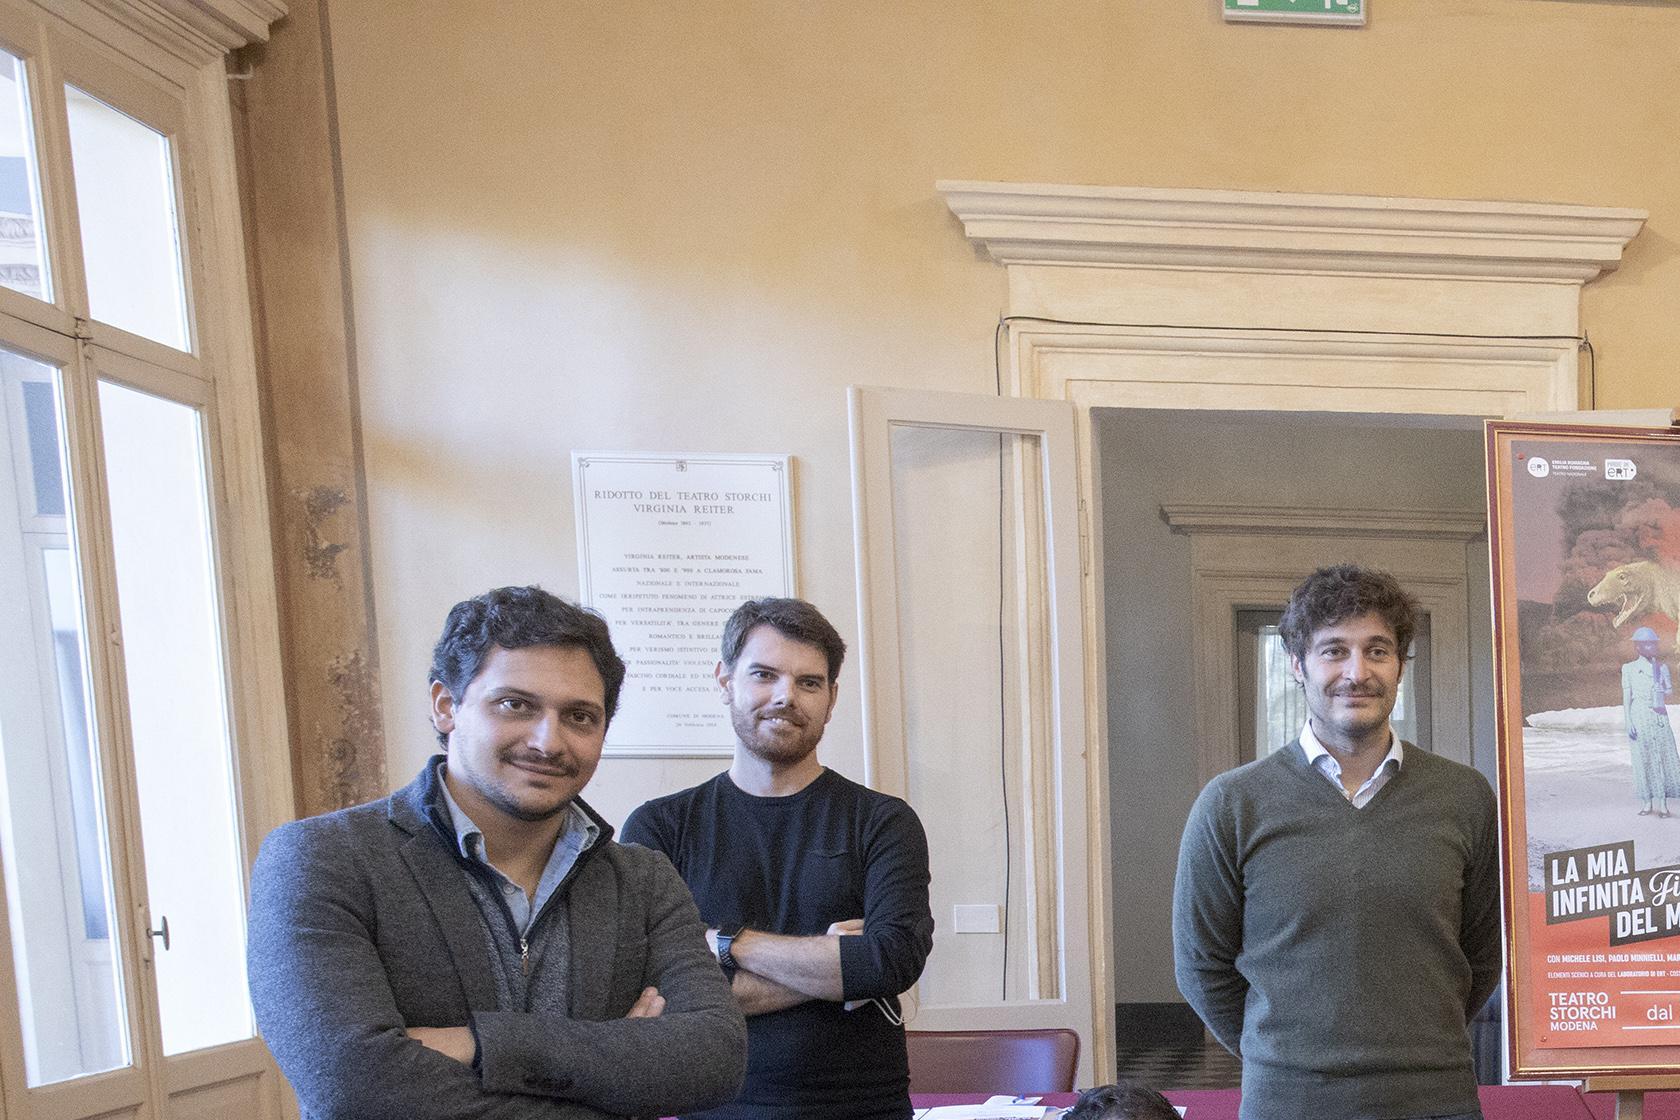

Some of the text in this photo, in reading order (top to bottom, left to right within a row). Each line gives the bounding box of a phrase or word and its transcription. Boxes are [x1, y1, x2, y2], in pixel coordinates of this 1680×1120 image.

[594, 490, 771, 502] RIDOTTO DEL TEATRO STORCHI
[633, 504, 735, 514] VIRGINIA REITER
[1551, 848, 1629, 885] LA MIA
[1552, 877, 1645, 917] INFINITA
[1616, 907, 1658, 939] DEL
[1547, 955, 1560, 964] CON
[1562, 954, 1591, 963] MICHELE
[1608, 954, 1629, 962] PAOLO
[1549, 992, 1609, 1006] TEATRO
[1550, 1006, 1616, 1020] STORCHI
[1646, 1004, 1673, 1020] dal
[1550, 1021, 1598, 1032] MODENA
